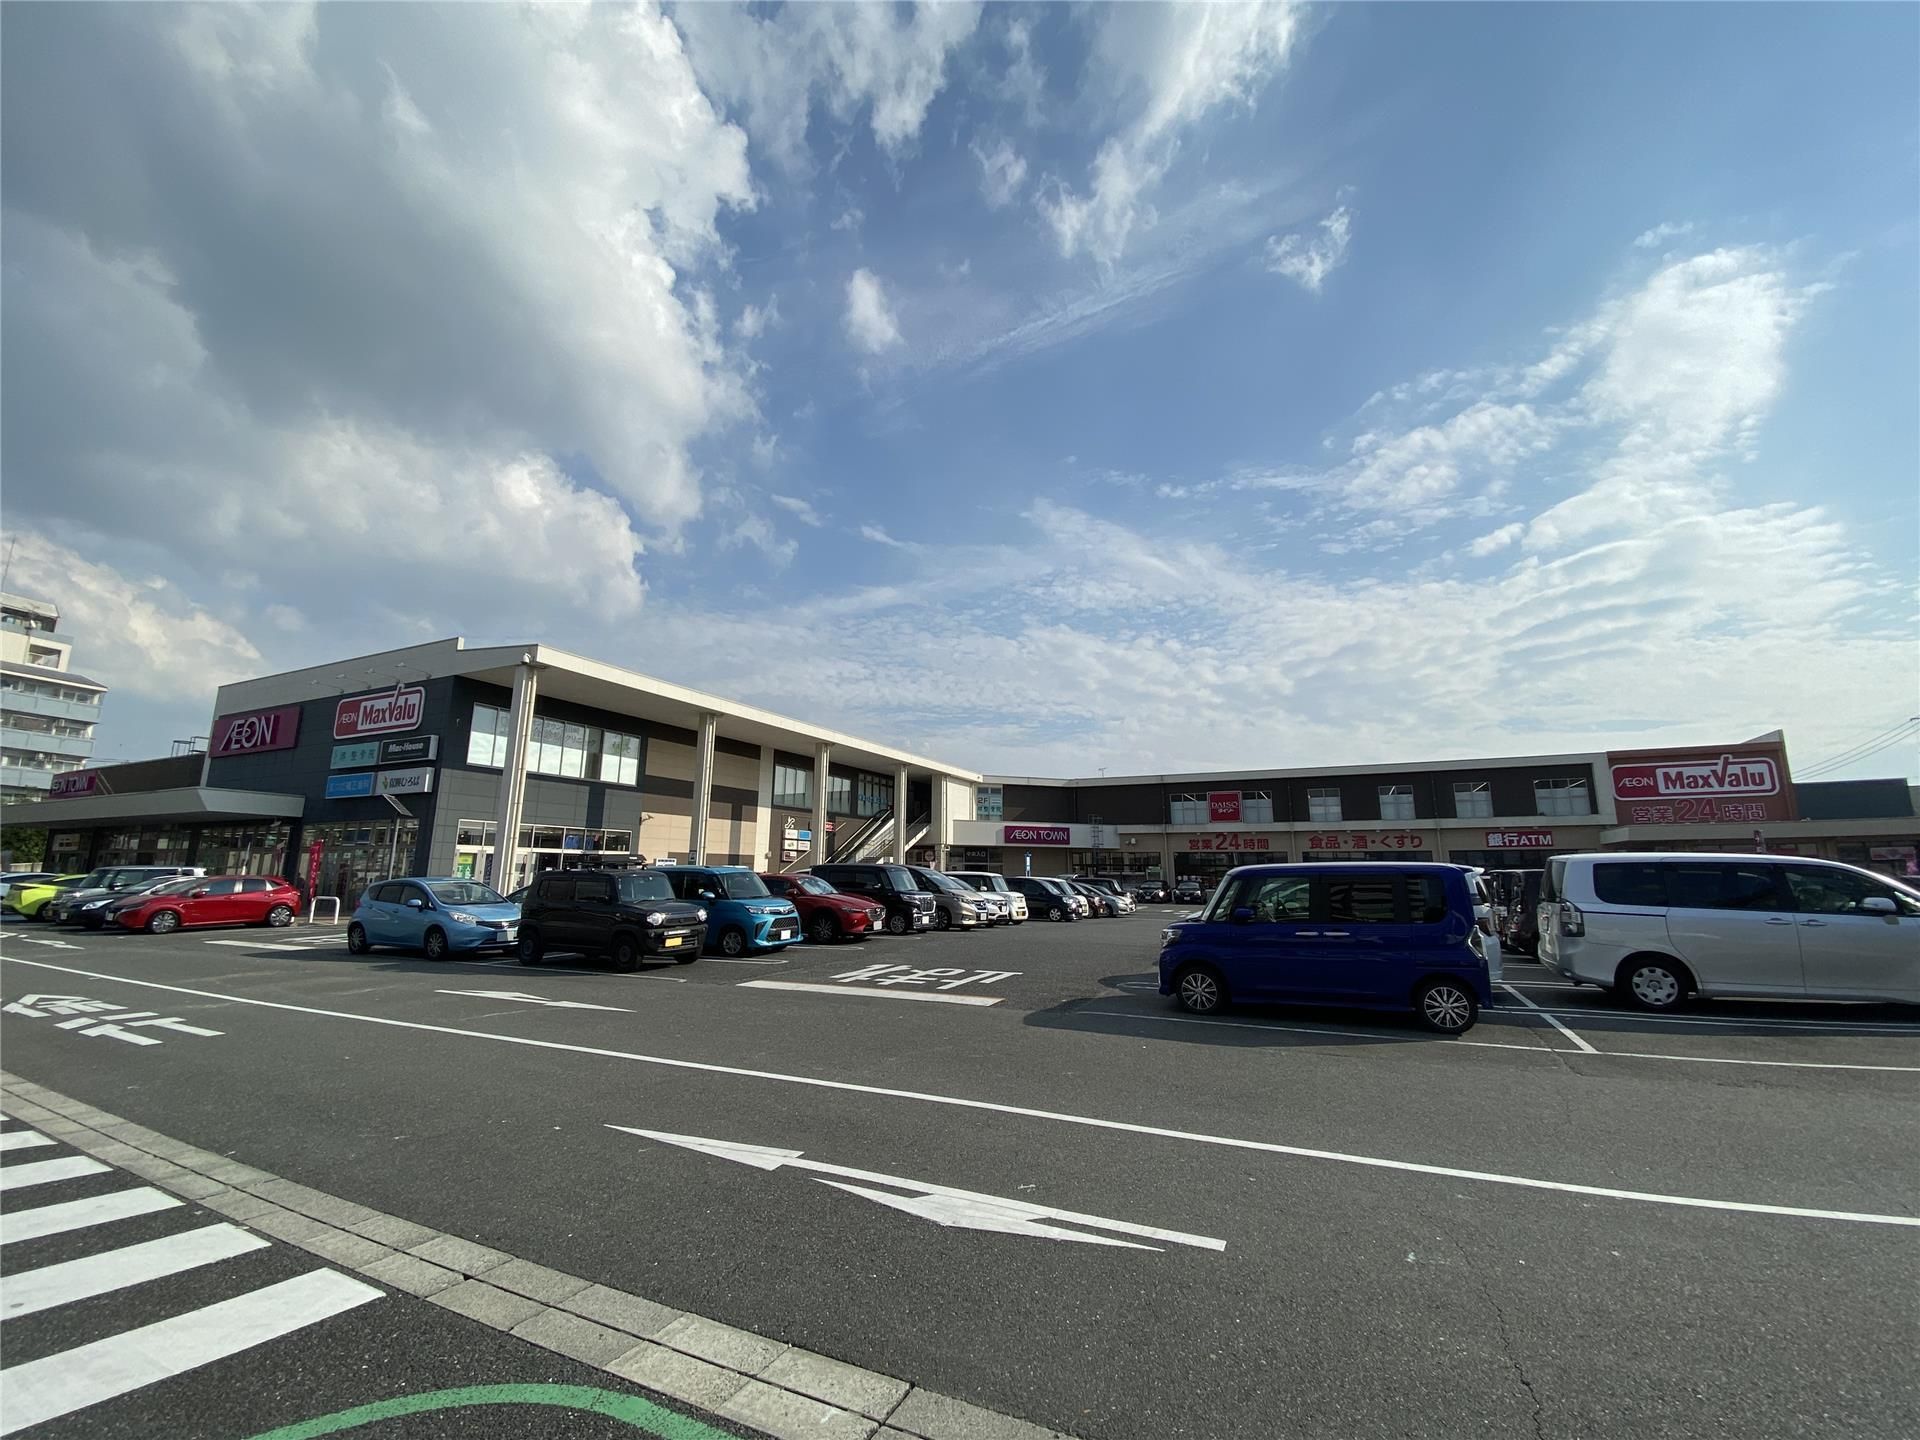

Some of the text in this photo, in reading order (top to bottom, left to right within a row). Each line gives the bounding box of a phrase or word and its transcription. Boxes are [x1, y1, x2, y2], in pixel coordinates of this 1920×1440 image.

[360, 687, 417, 726] MaxValu
[1661, 756, 1766, 789] MaxValu
[1211, 801, 1239, 809] DAISO
[1631, 799, 1767, 823] 営業24時間
[1038, 828, 1068, 840] TOWN
[1188, 832, 1269, 850] 営業24時間
[1487, 833, 1553, 848] 銀行ATM
